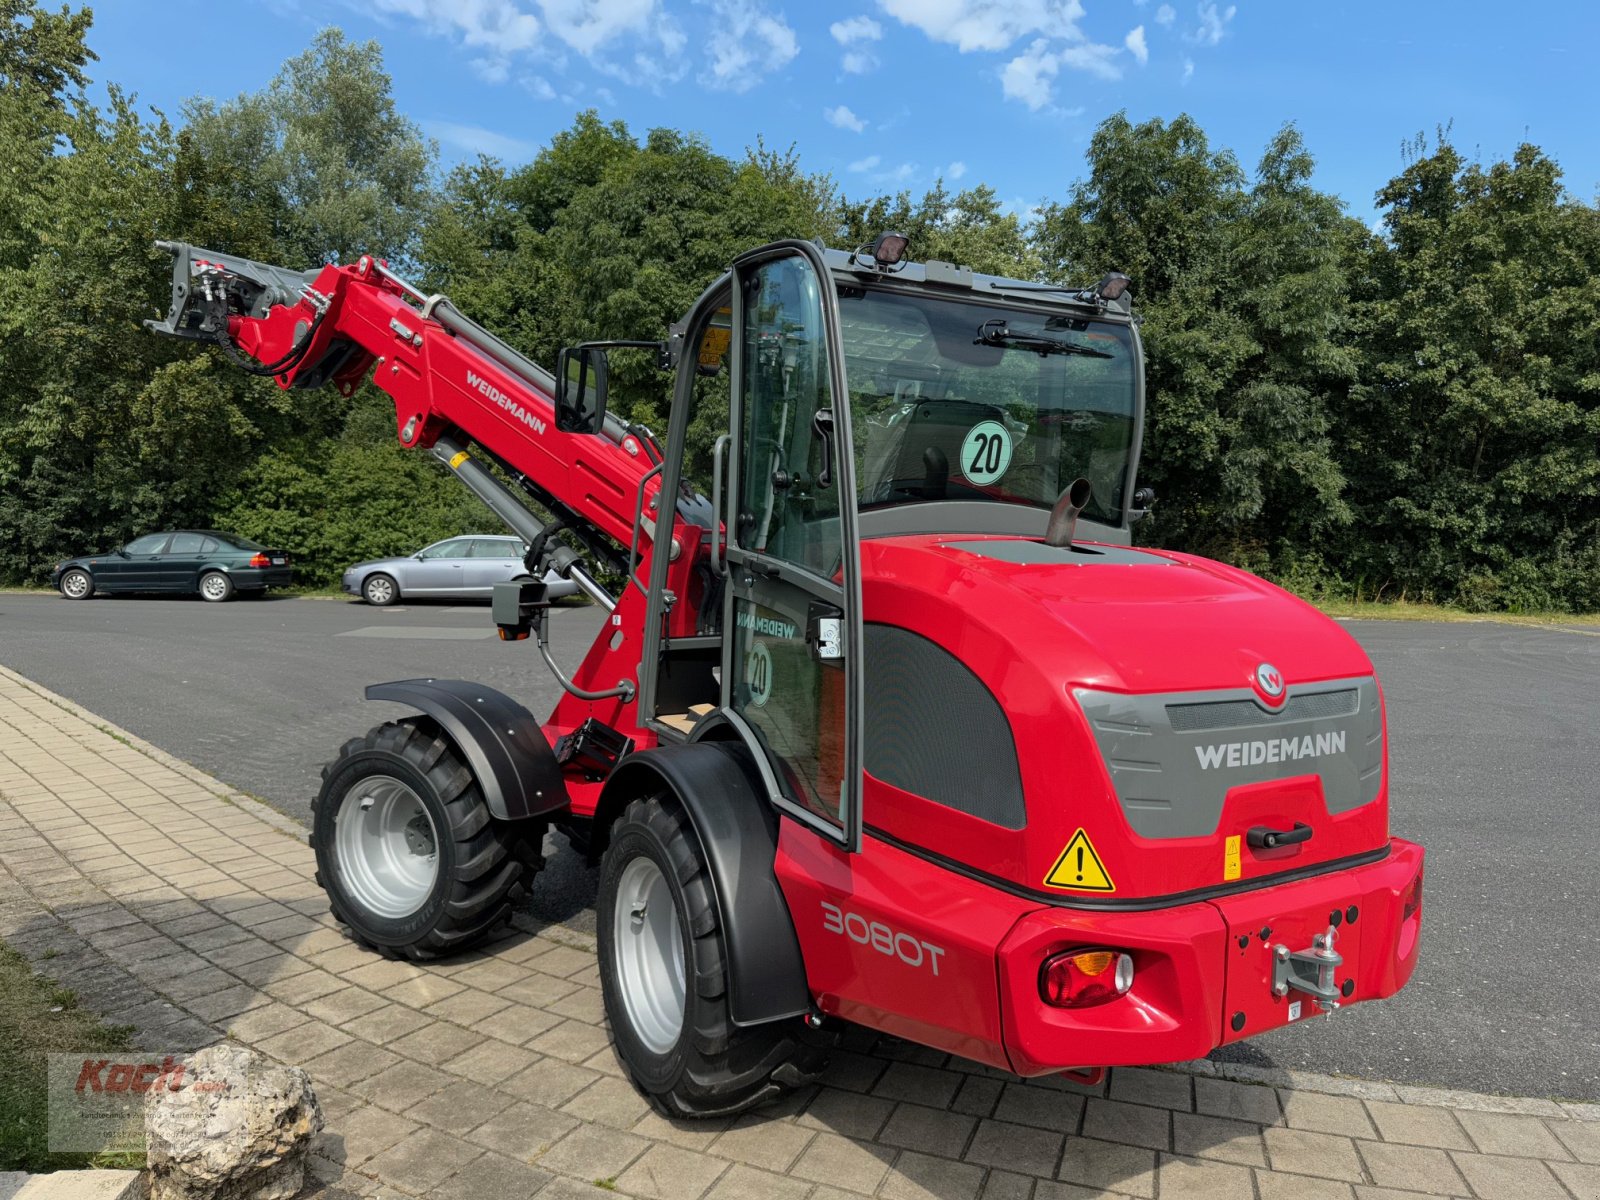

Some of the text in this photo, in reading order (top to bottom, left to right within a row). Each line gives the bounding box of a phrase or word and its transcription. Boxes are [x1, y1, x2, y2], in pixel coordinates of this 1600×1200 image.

[466, 370, 547, 435] WEIDEMANN
[969, 432, 1003, 474] 20
[752, 651, 767, 695] 20
[1195, 731, 1346, 769] WEIDEMANN
[821, 901, 945, 976] 3080T
